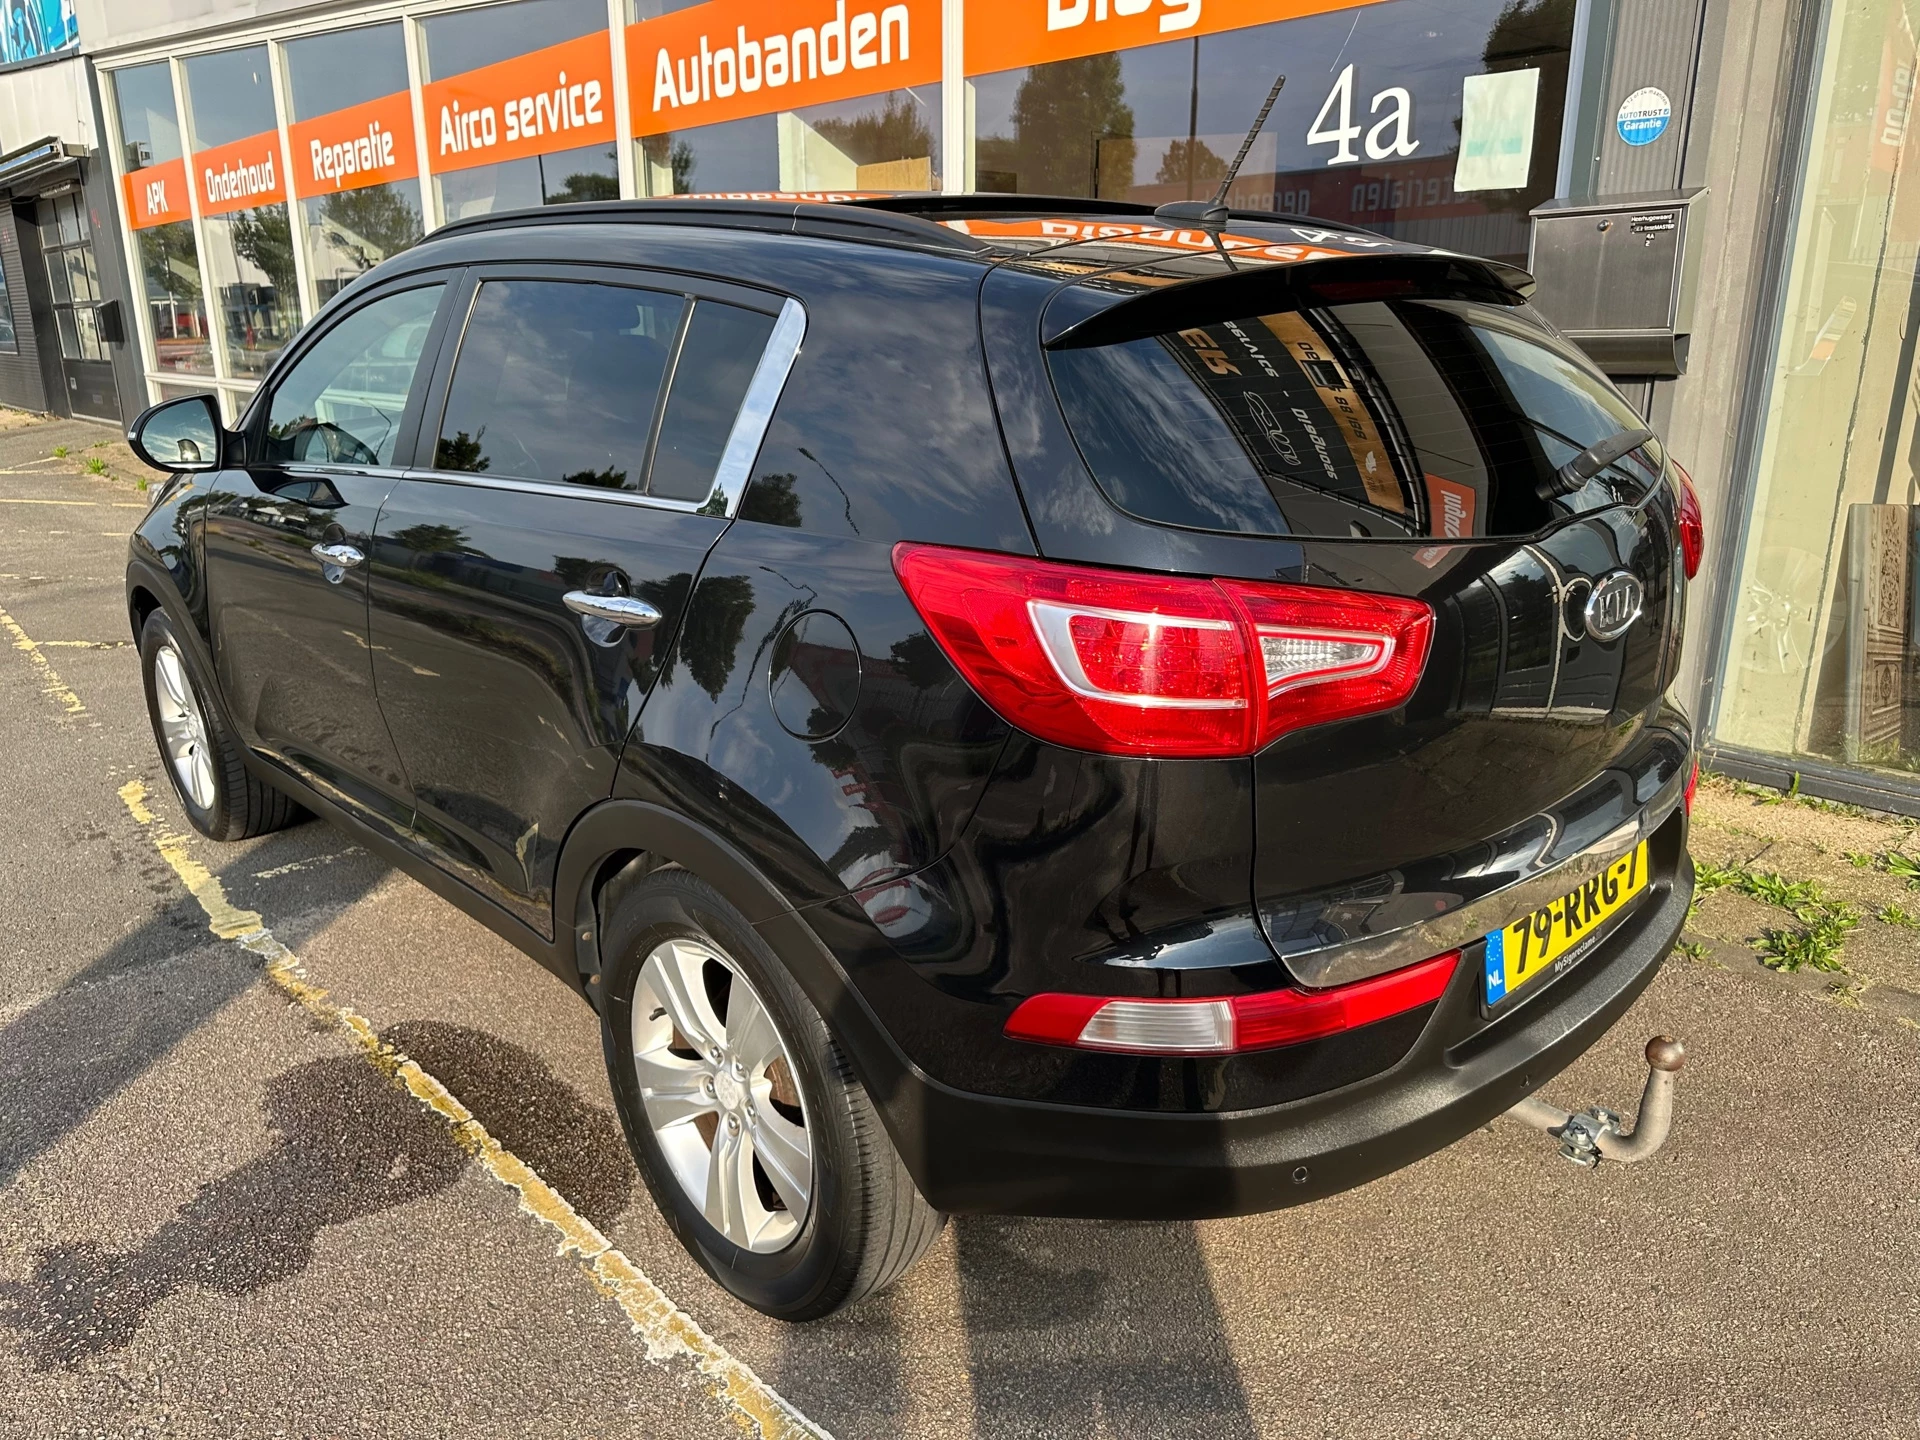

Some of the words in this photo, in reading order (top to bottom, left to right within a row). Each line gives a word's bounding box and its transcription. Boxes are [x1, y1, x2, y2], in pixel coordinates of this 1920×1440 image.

[652, 0, 910, 112] Autobanden
[440, 100, 497, 156] Airco
[504, 71, 603, 142] service
[1306, 62, 1420, 166] 4a
[1619, 108, 1662, 119] AUTOTRUST
[1623, 119, 1662, 131] Garantie
[205, 151, 276, 203] Onderhoud
[310, 120, 396, 188] Reparatie
[146, 179, 169, 216] APK
[1598, 584, 1636, 629] KIA
[1488, 969, 1503, 990] NL
